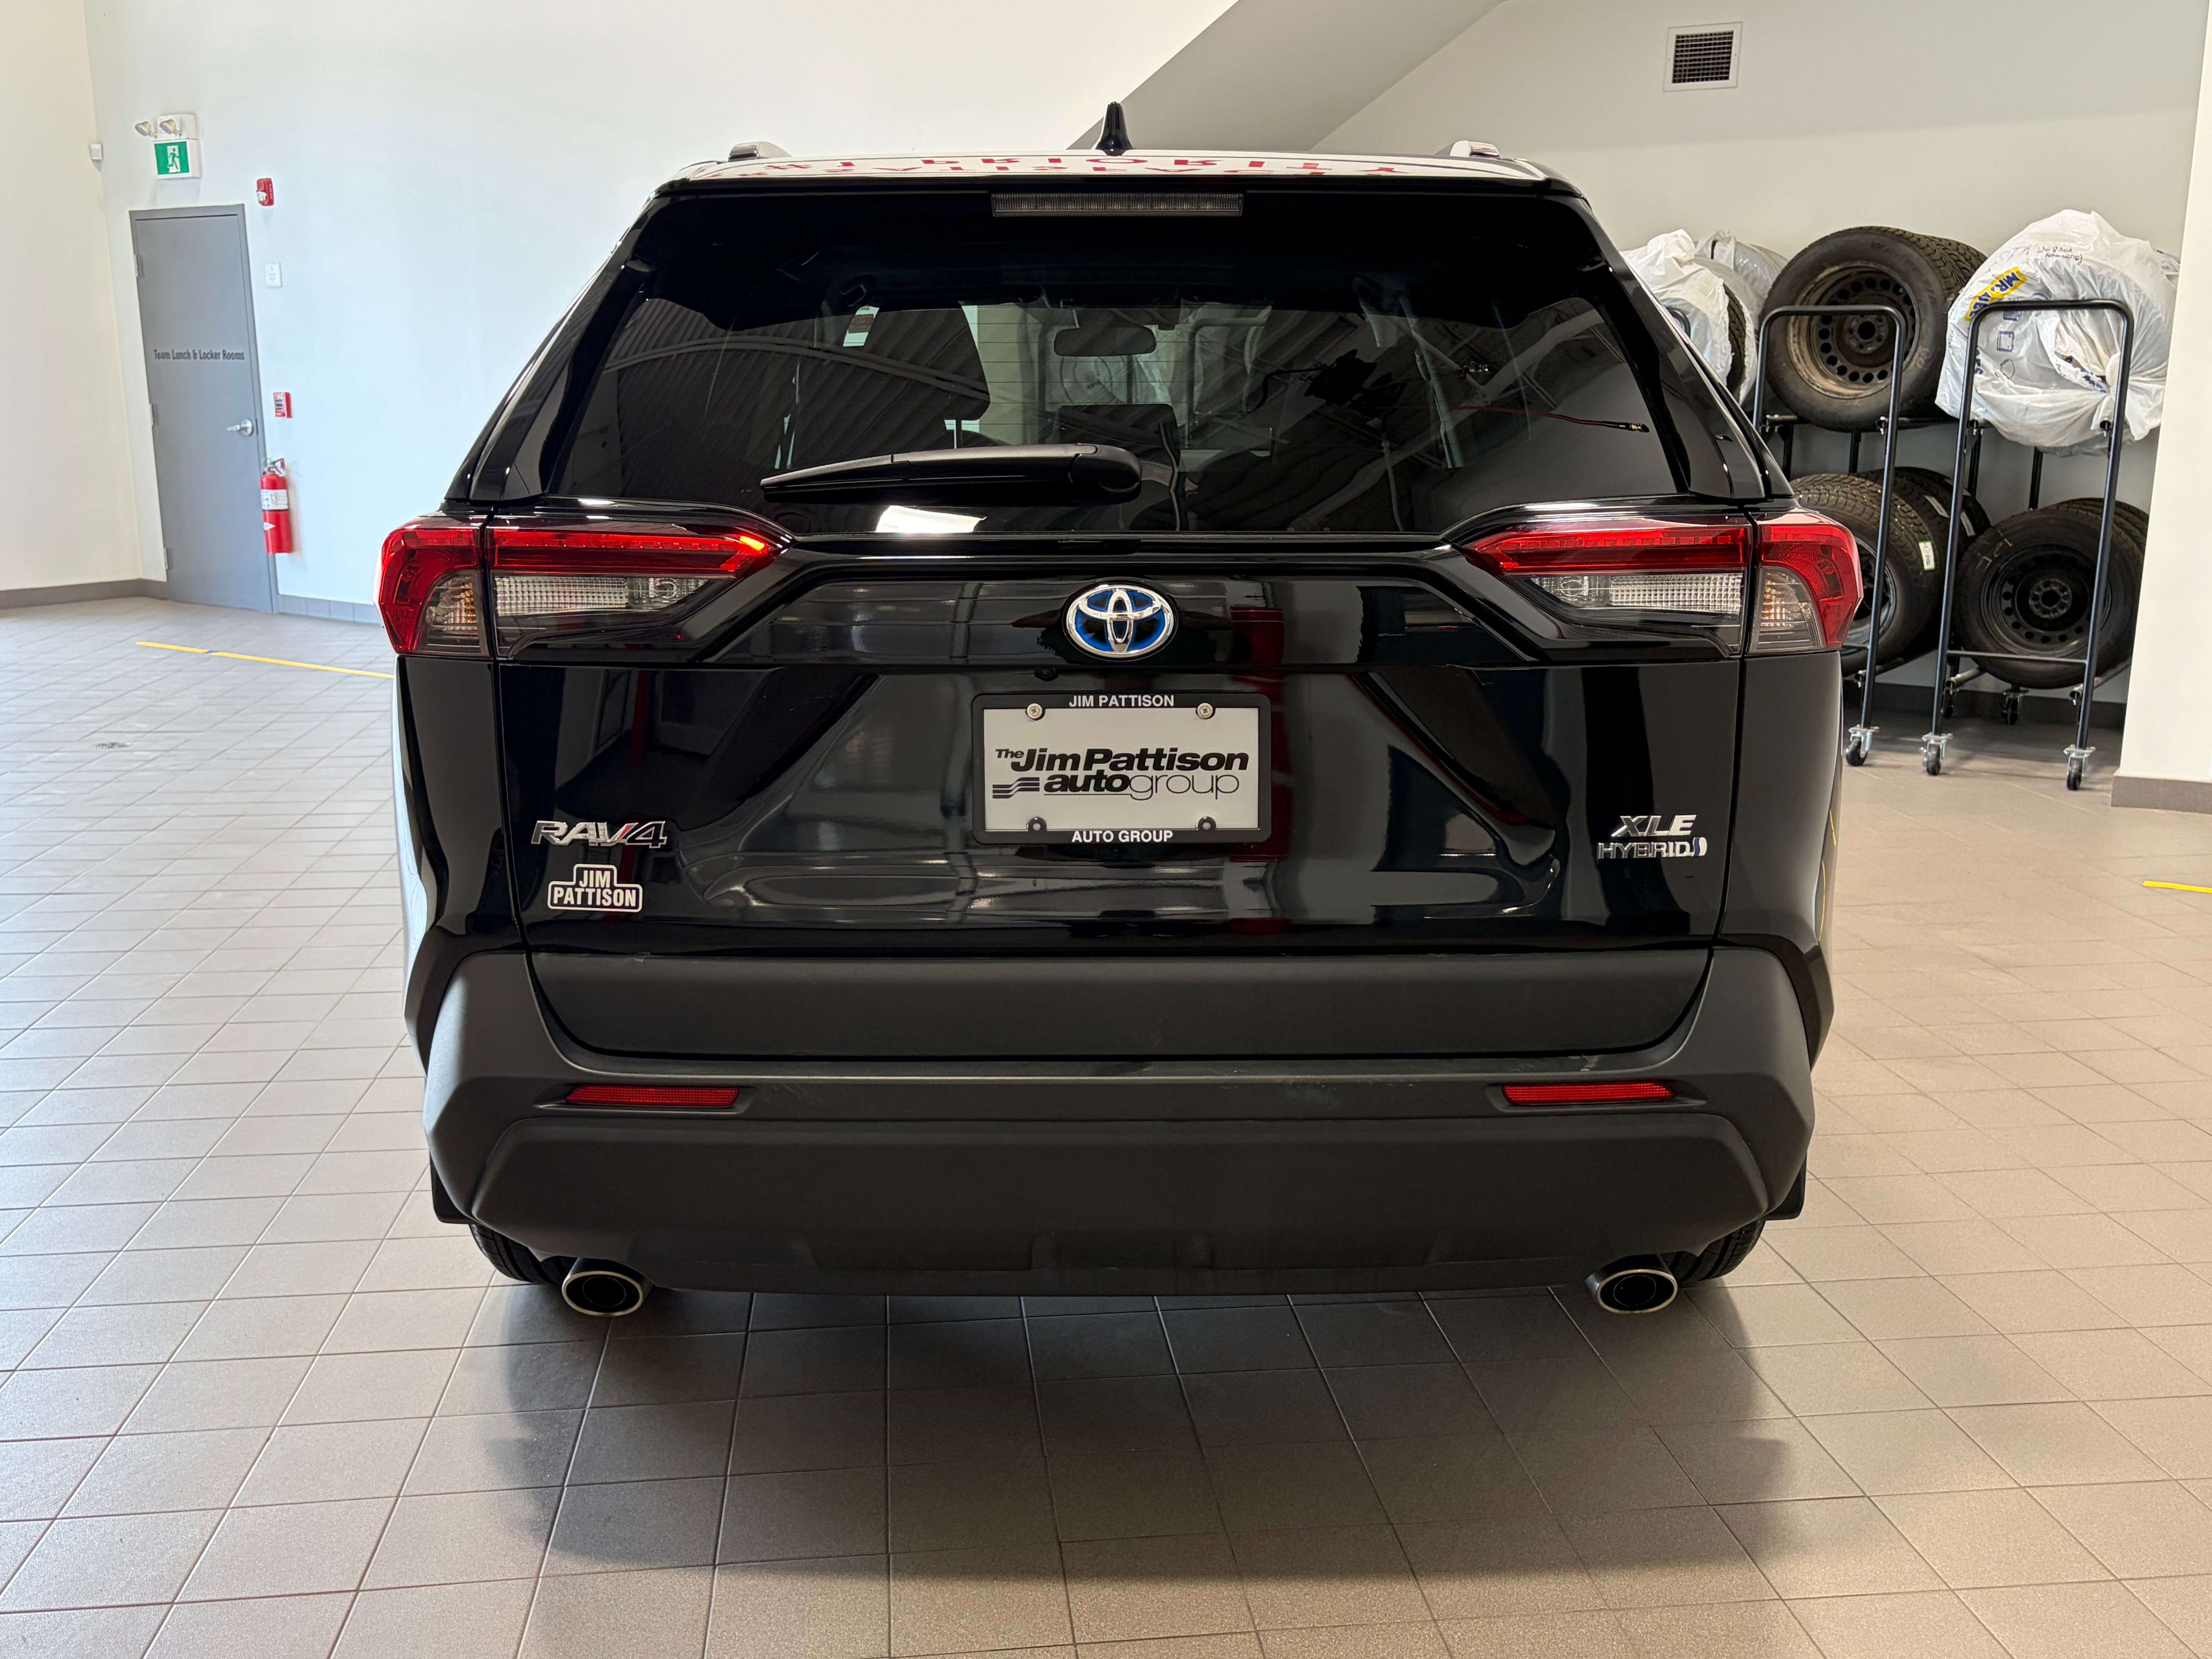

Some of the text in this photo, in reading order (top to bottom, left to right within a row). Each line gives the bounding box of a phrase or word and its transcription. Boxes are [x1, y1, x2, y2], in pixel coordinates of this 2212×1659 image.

[153, 349, 245, 360] Team Lunch & Locker Rooms
[1069, 695, 1175, 707] JIM PATTISON
[996, 747, 1249, 771] The Jim Pattison
[1044, 770, 1239, 800] autogroup
[531, 820, 668, 849] RAV4
[1611, 814, 1697, 837] XLE
[1072, 830, 1173, 843] AUTO GROUP
[1597, 841, 1693, 859] HYBRID
[579, 870, 611, 888] JIM
[553, 887, 636, 907] PATTISON
